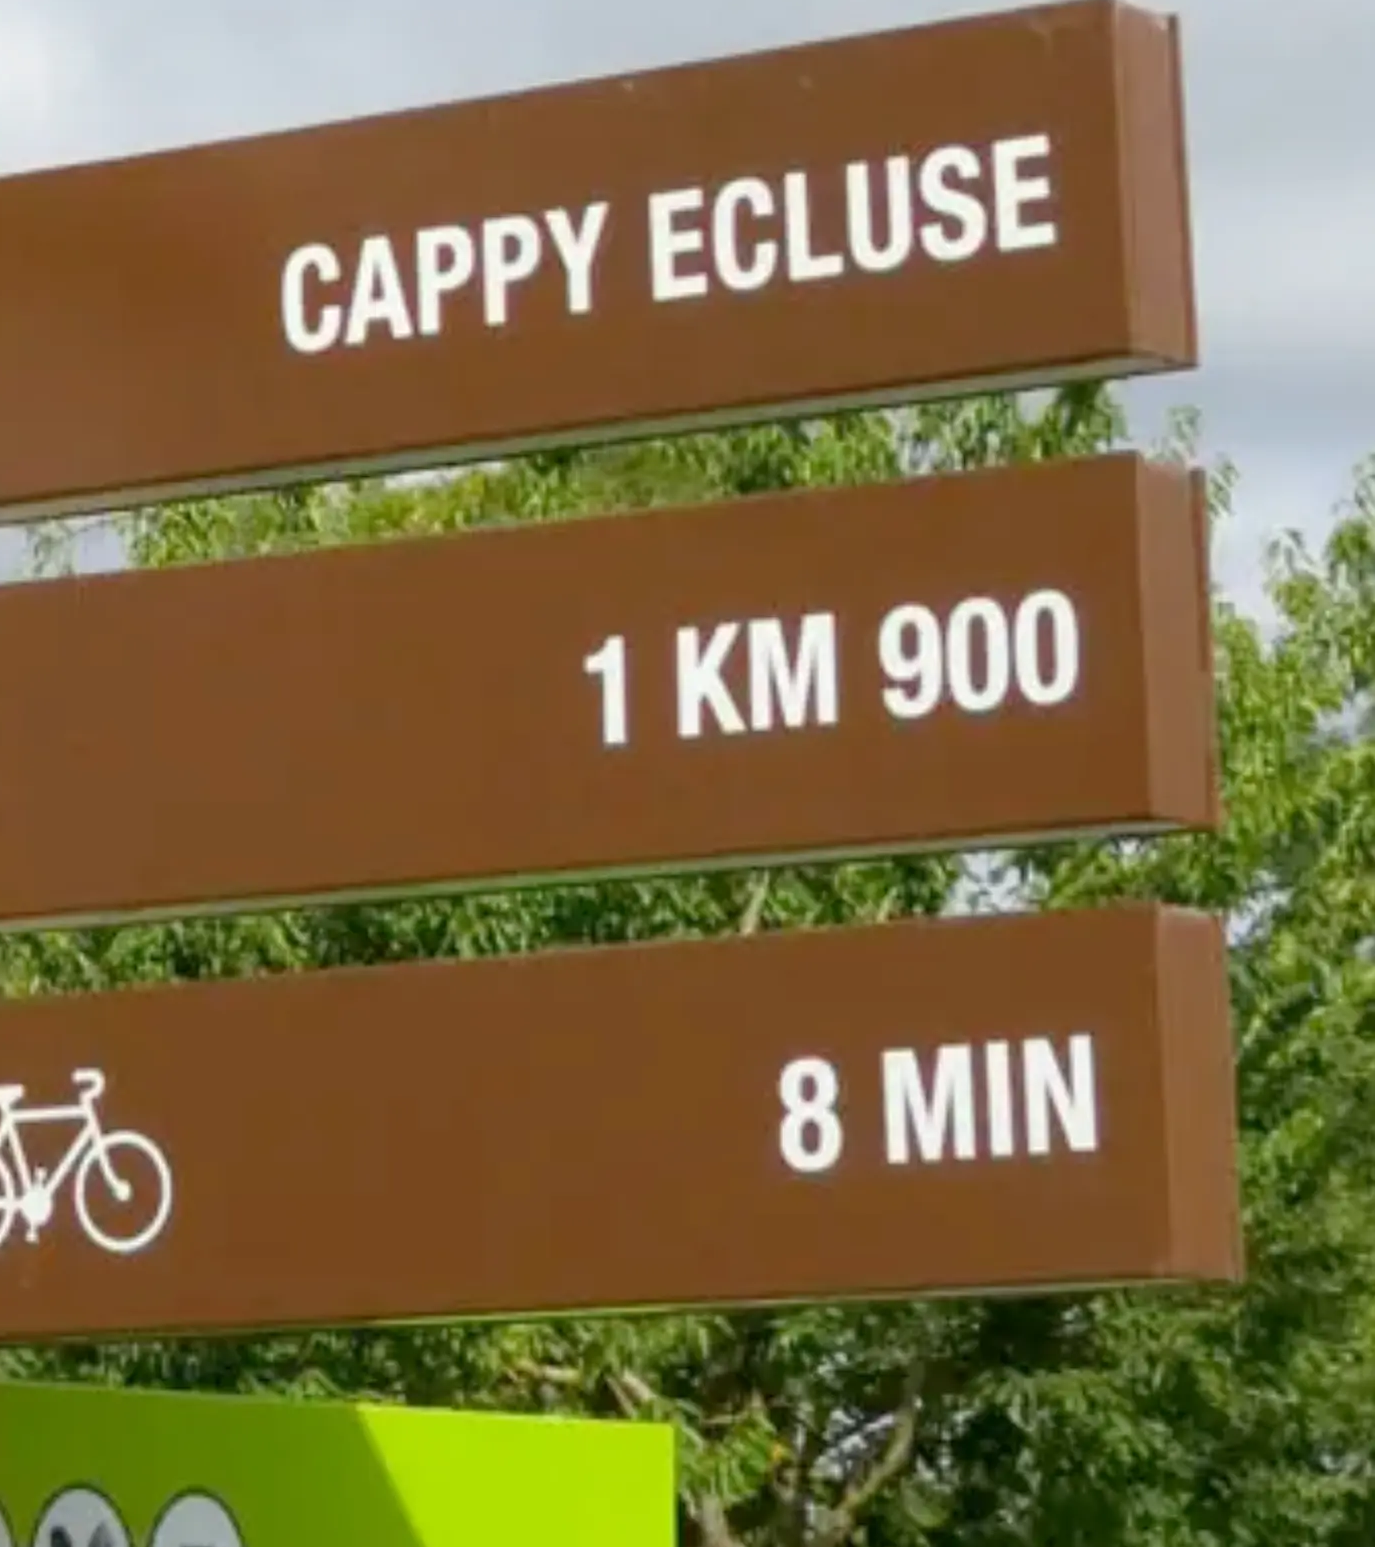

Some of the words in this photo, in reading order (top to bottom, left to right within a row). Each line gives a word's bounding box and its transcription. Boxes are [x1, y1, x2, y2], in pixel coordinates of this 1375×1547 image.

[282, 201, 607, 352] CAPPY
[650, 135, 1056, 302] ECLUSE
[584, 636, 630, 745] 1
[677, 612, 838, 736] KM
[879, 588, 1080, 719] 900
[779, 1057, 842, 1172] 8
[884, 1035, 1097, 1164] MIN
